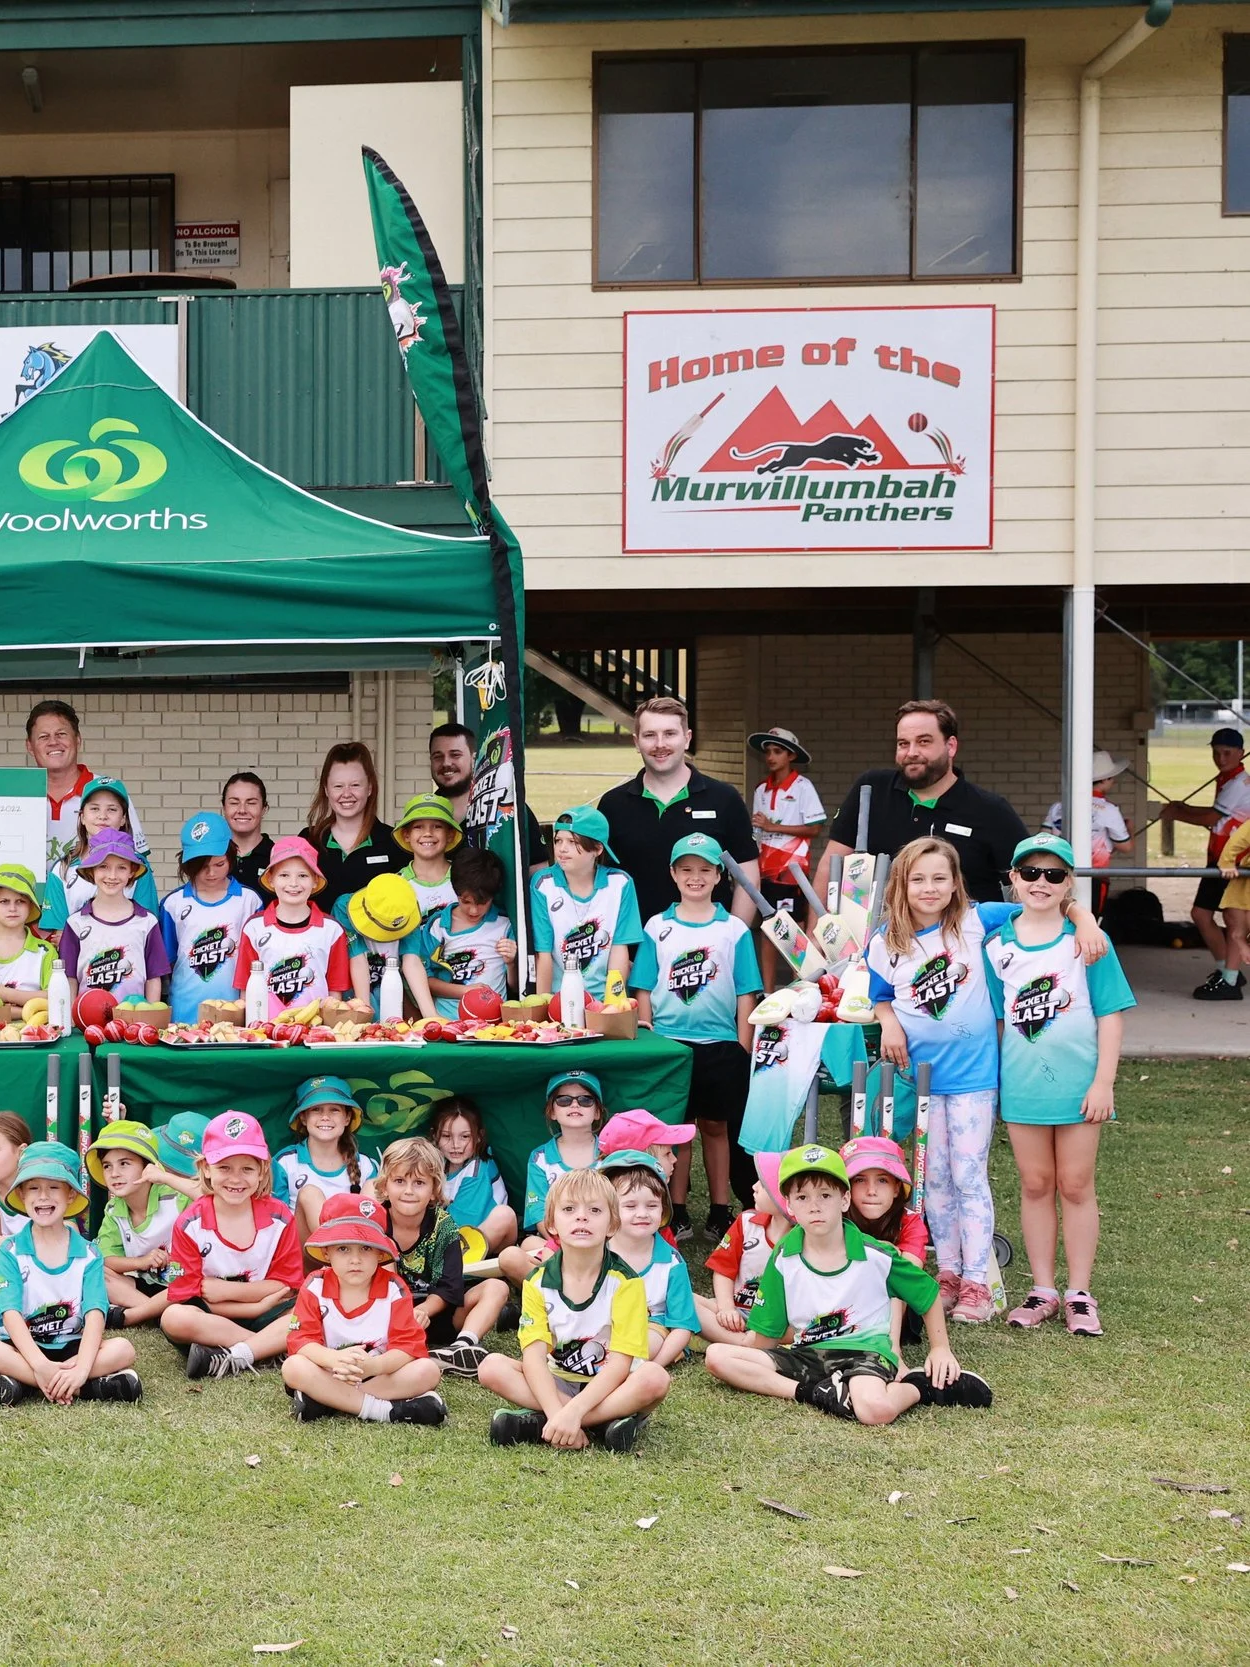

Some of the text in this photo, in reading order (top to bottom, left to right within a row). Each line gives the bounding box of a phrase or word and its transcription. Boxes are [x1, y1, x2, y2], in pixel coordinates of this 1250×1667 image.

[176, 227, 236, 236] NO ALCOHOL
[203, 240, 228, 248] Brought
[648, 337, 961, 393] Home of the
[651, 473, 957, 502] Murwillumbah
[801, 503, 953, 522] Panthers
[192, 941, 221, 955] CRICKET
[565, 935, 593, 951] CRICKET
[190, 947, 229, 967] BLAST
[89, 961, 118, 975] CRICKET
[270, 969, 299, 984] CRICKET
[671, 963, 702, 977] CRICKET
[86, 969, 125, 987] BLAST
[668, 970, 711, 991] BLAST
[912, 974, 959, 1005] BLAST
[1014, 992, 1050, 1010] CRICKET
[1012, 999, 1061, 1025] BLAST
